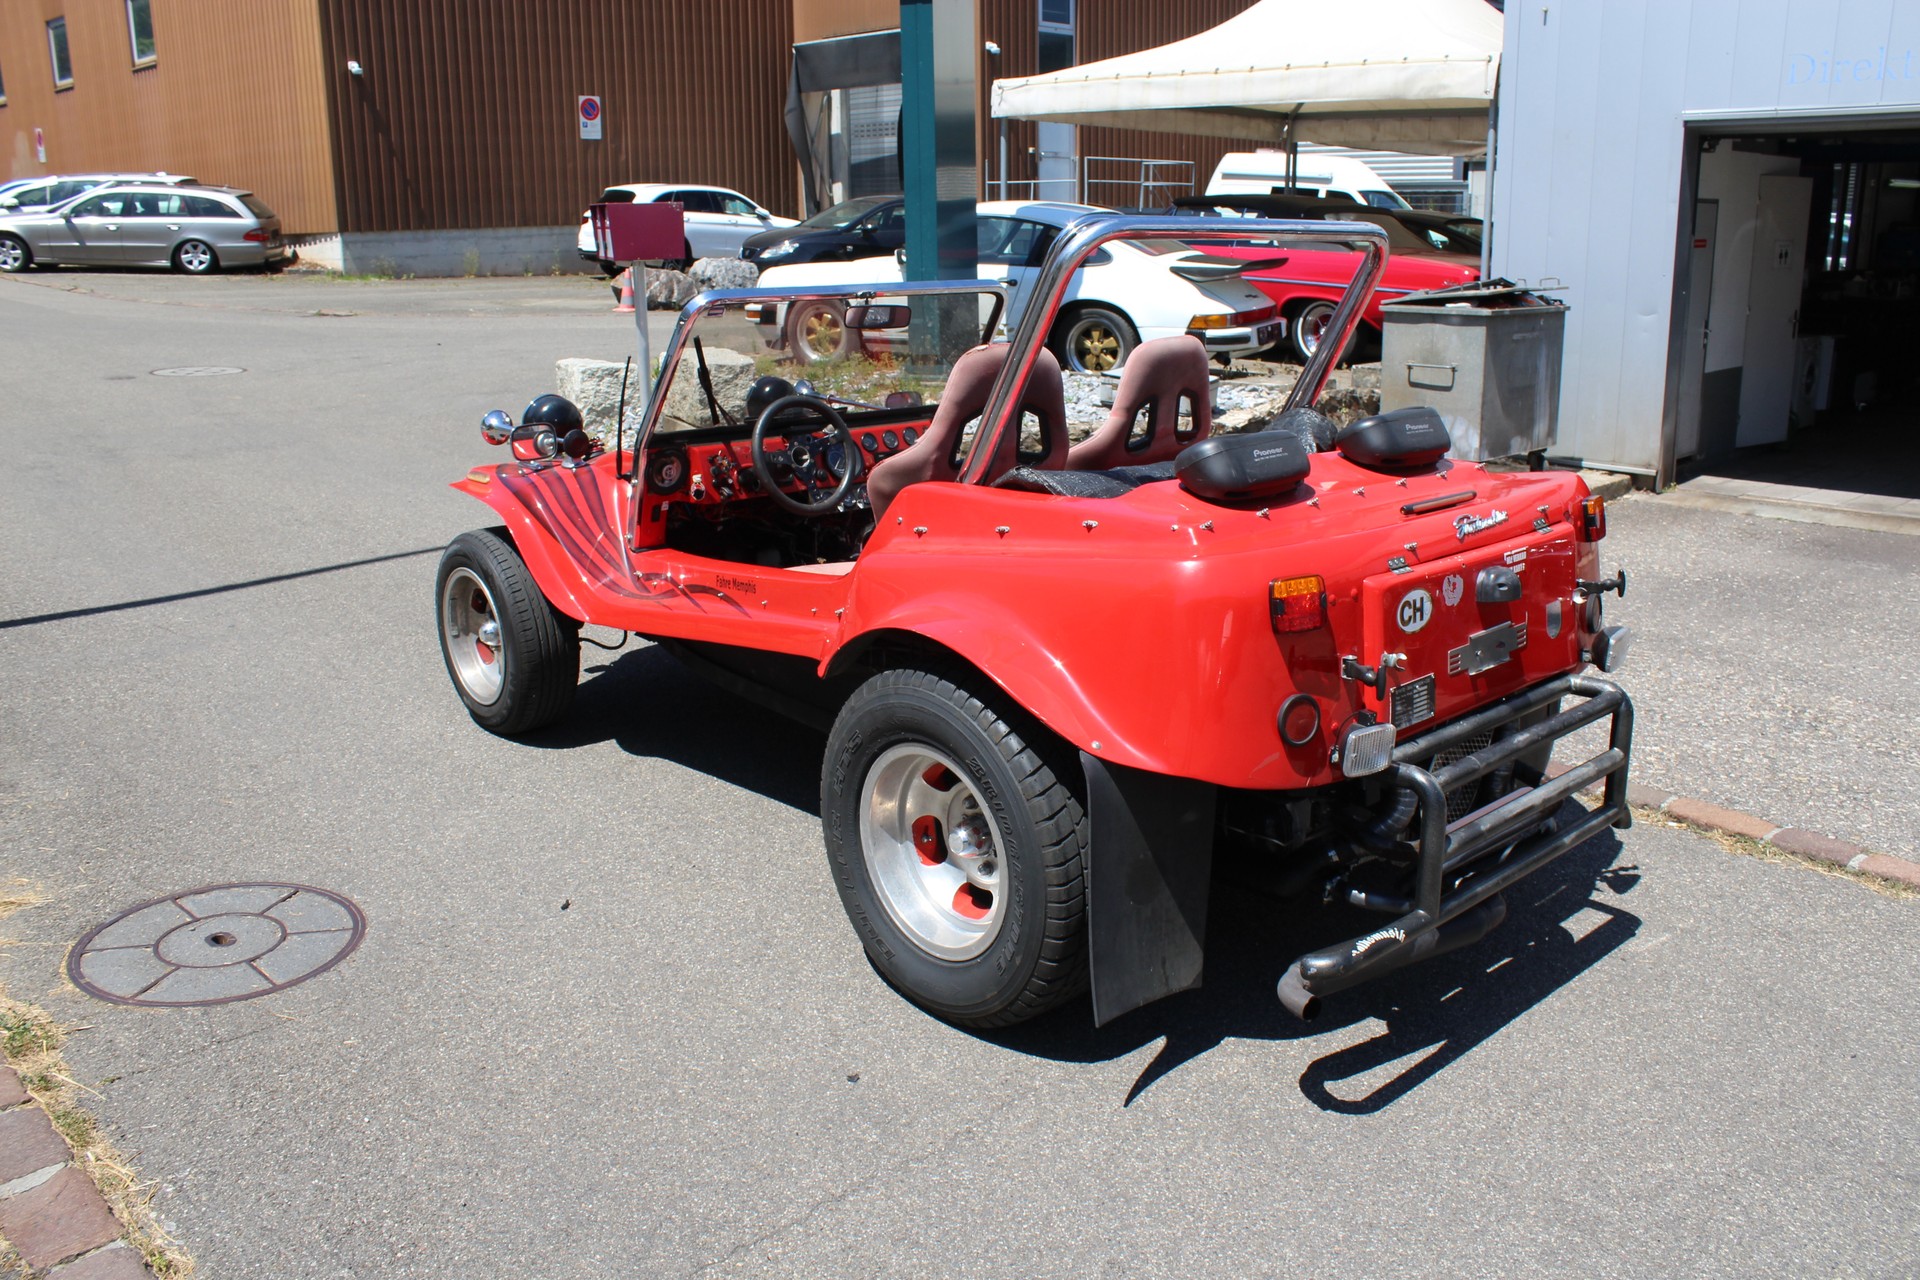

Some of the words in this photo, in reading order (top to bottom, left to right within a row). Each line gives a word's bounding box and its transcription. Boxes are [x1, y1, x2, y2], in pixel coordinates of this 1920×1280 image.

[1787, 46, 1920, 85] Direkt
[1406, 423, 1429, 431] Pioneer
[1253, 447, 1283, 458] Pioneer
[716, 575, 731, 590] Fahre
[732, 577, 757, 595] Memphis
[1400, 597, 1424, 627] CH
[965, 756, 1025, 977] BRIDGESTONE
